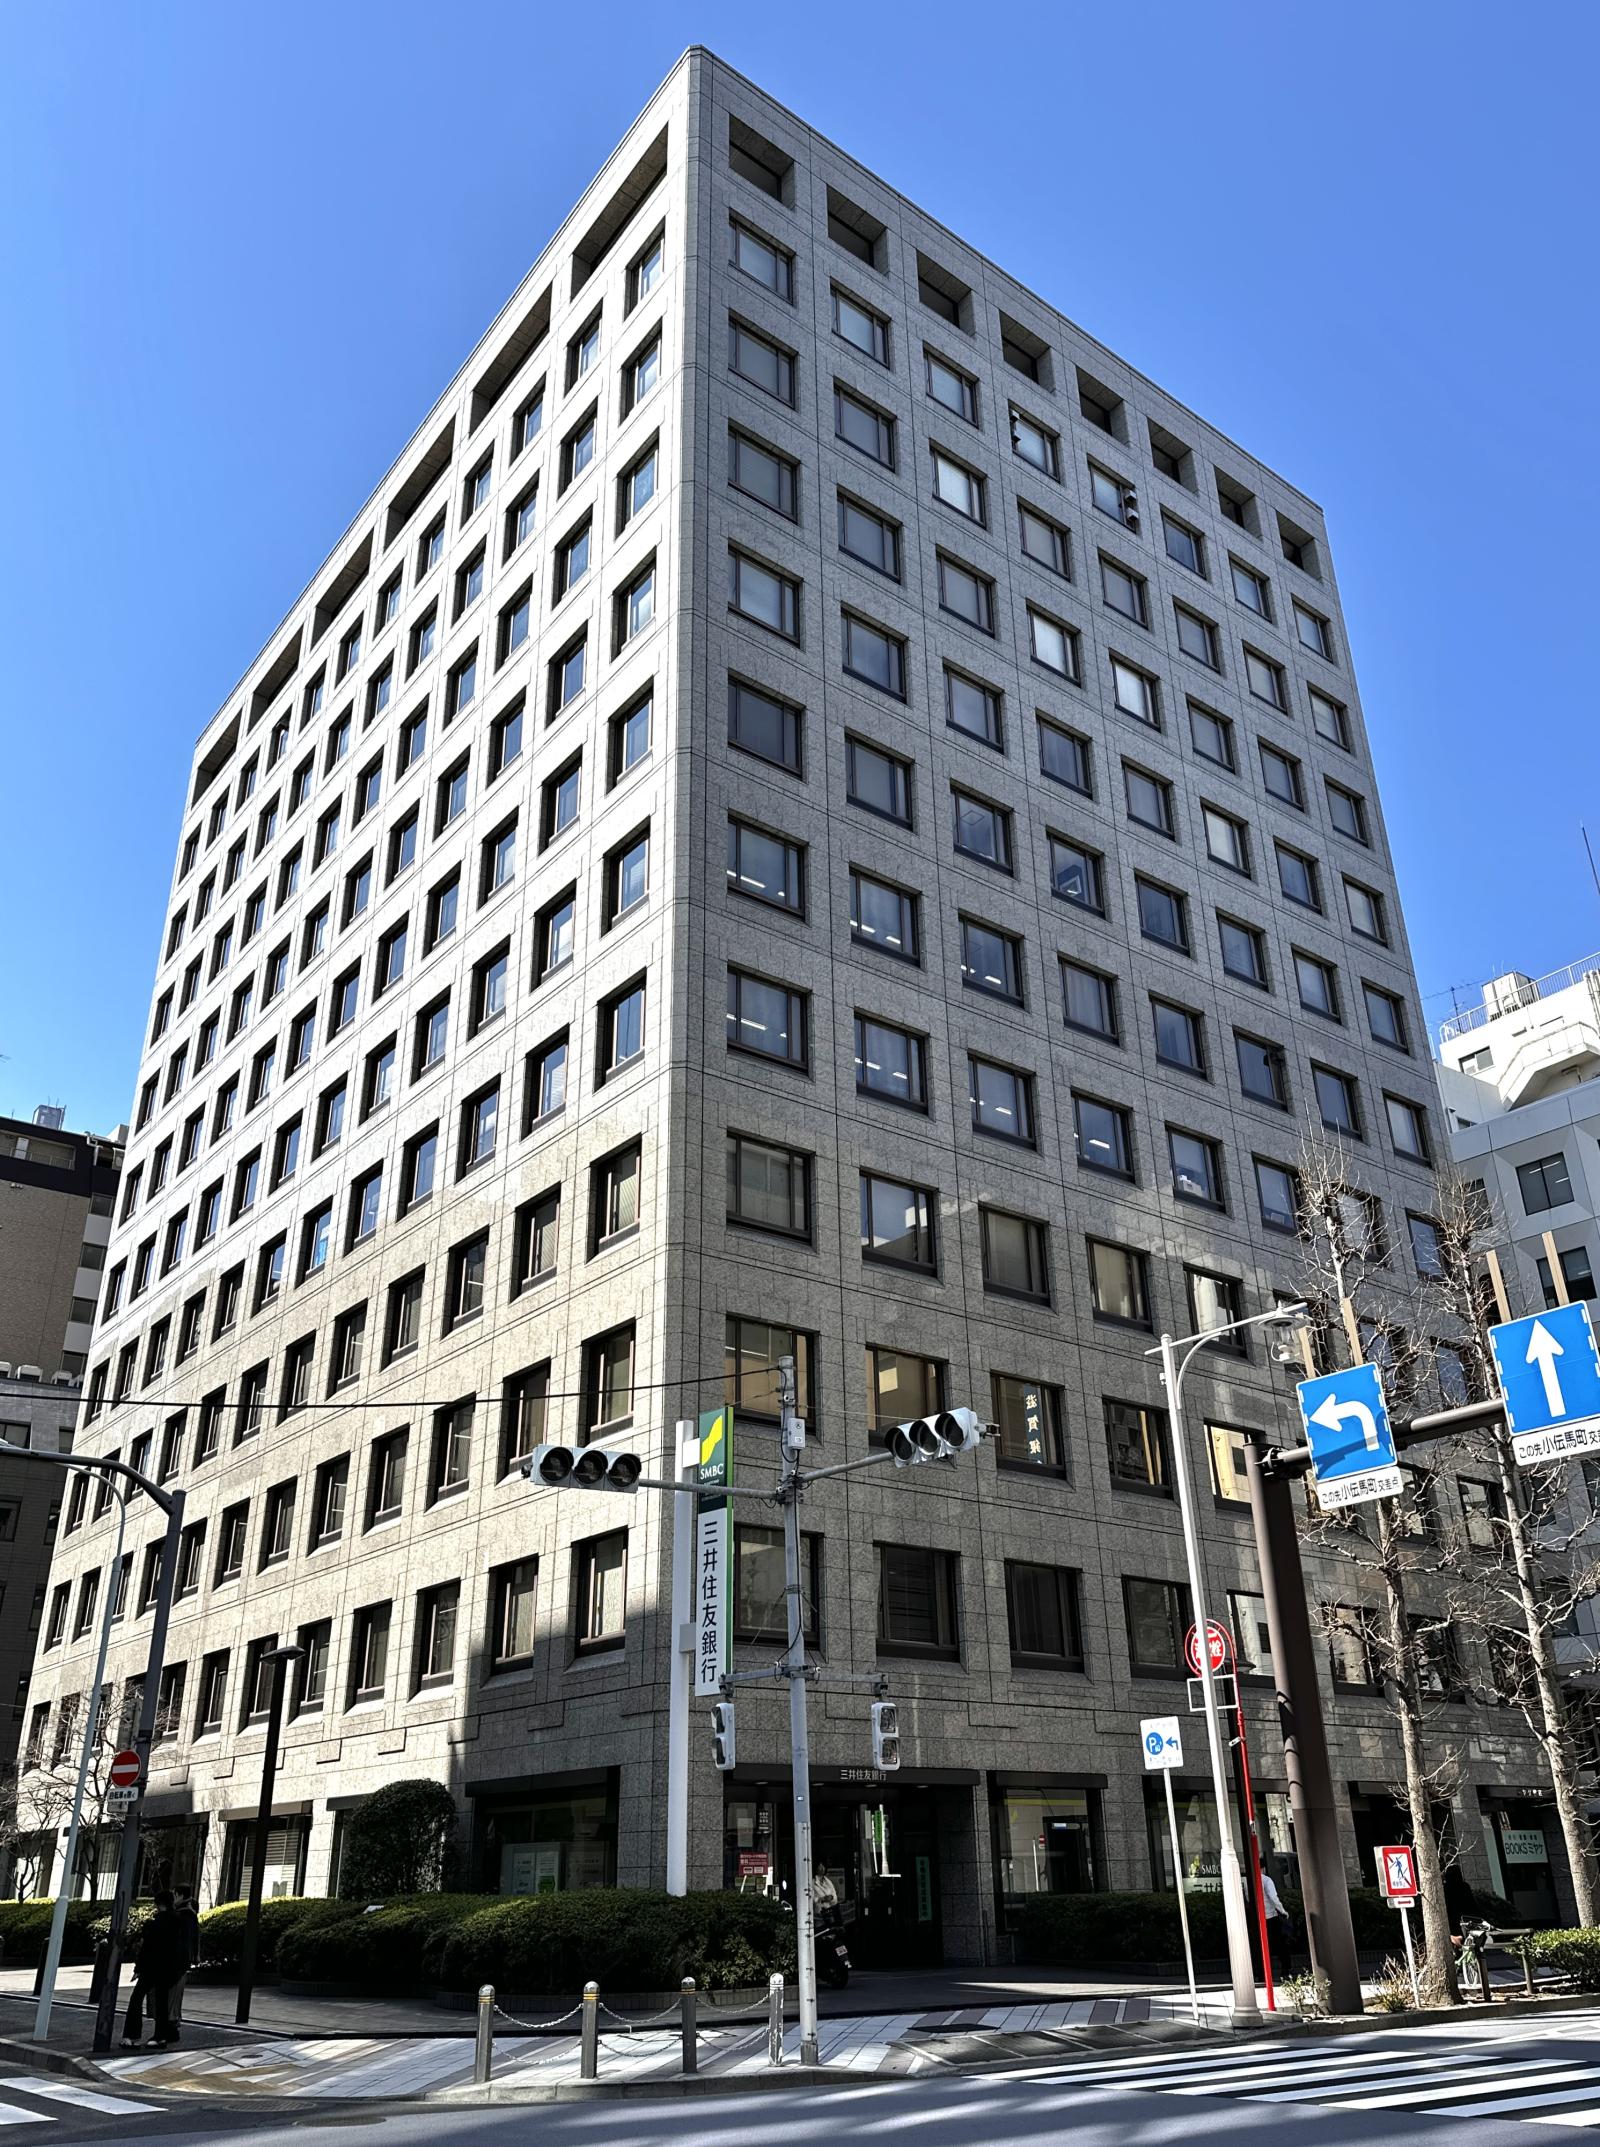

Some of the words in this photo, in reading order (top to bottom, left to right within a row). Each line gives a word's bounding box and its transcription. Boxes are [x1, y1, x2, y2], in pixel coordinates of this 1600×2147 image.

[1518, 1428, 1600, 1459] この先小伝馬町交
[700, 1463, 724, 1479] SMBC
[1322, 1476, 1399, 1504] この先小伝馬町交差点
[701, 1520, 718, 1684] 三井住友銀行
[840, 1769, 887, 1781] 三井住友銀行
